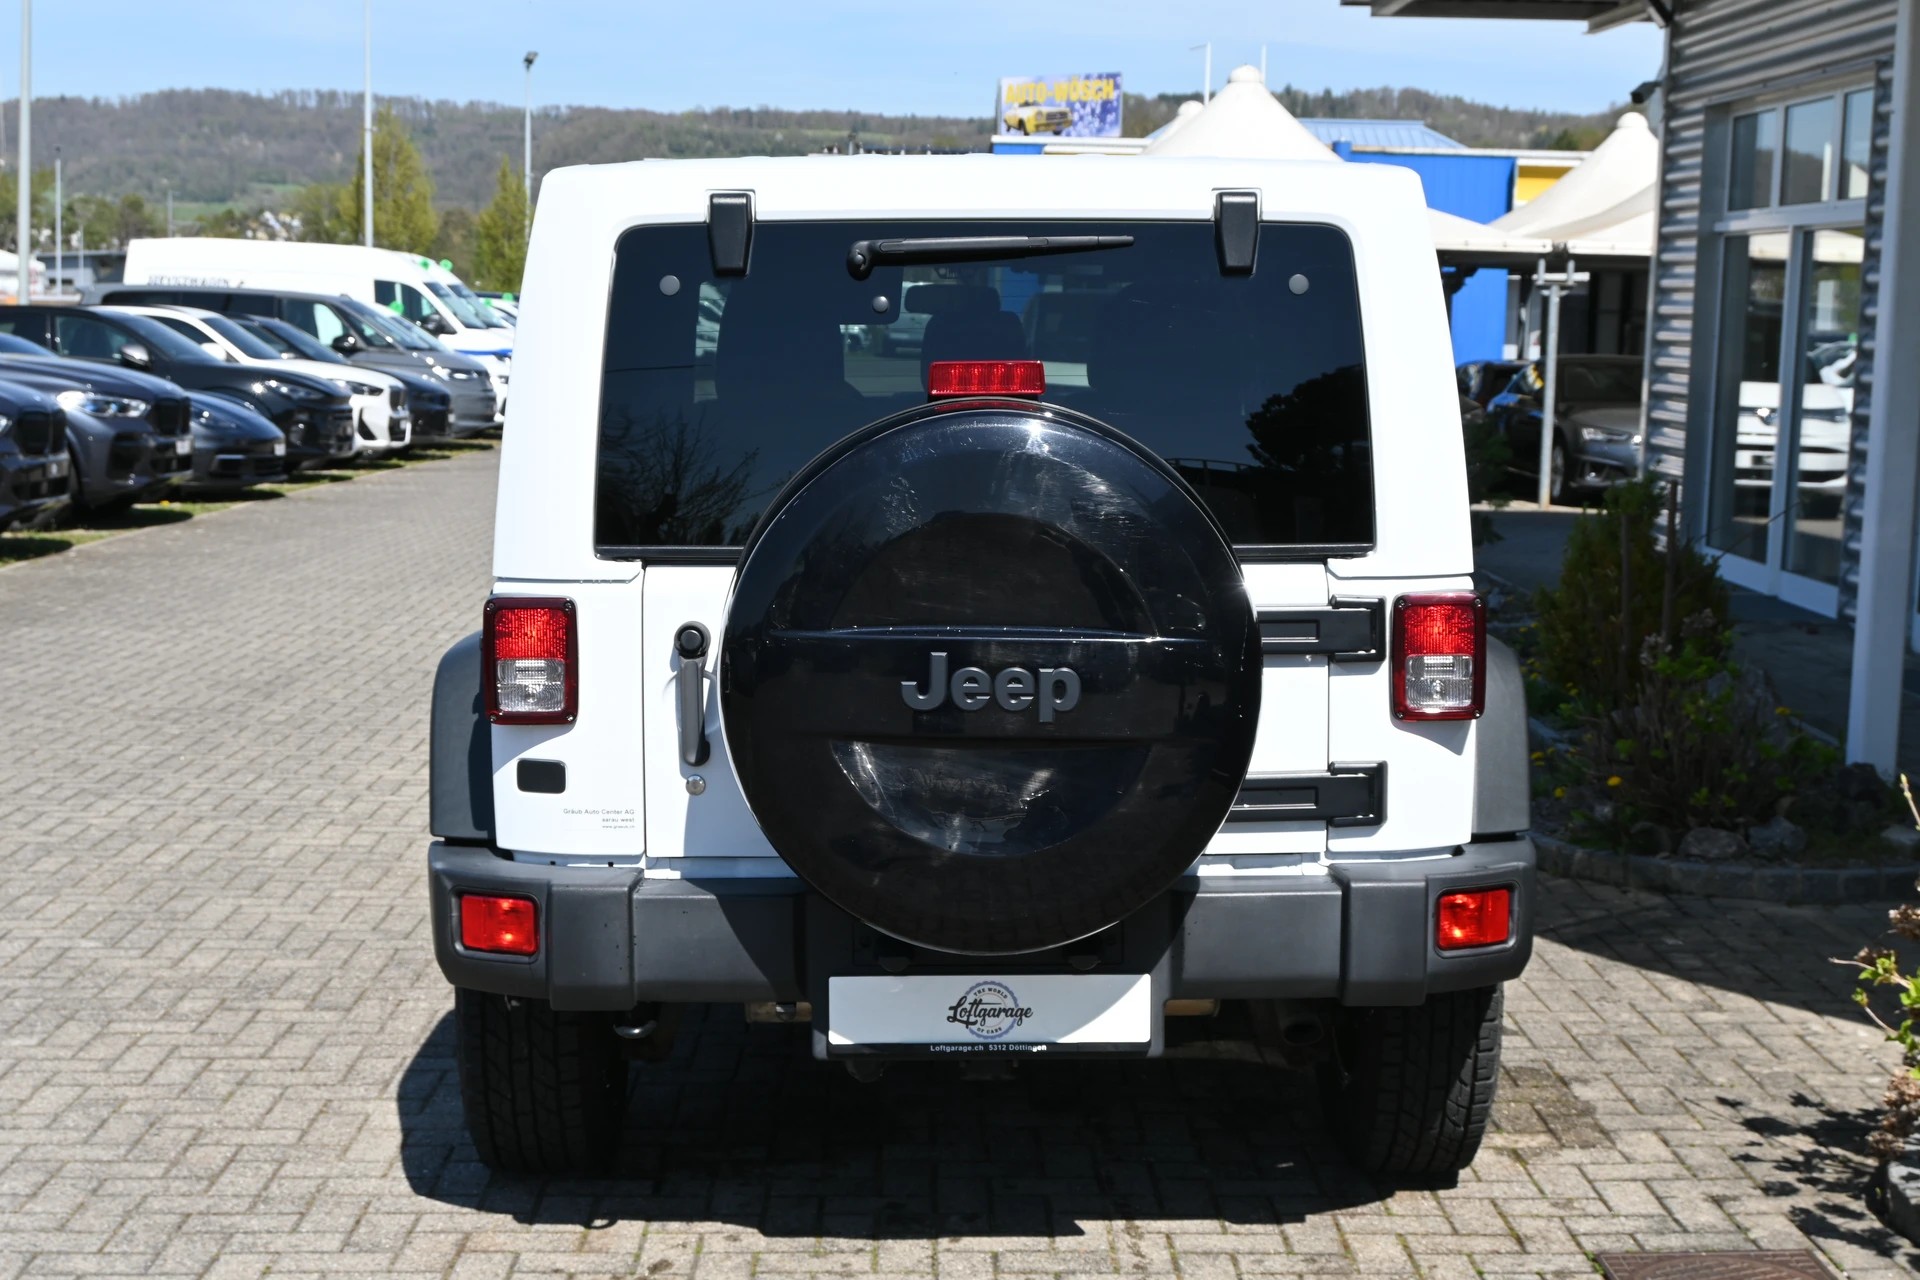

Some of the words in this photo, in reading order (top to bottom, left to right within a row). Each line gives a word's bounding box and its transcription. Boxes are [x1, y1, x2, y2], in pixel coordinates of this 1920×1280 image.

[1005, 75, 1114, 103] AUTO-WÖSCH
[900, 651, 1081, 723] Jeep
[973, 987, 986, 997] THE
[988, 987, 1008, 999] WORLD
[946, 996, 1034, 1029] Loftgarage
[930, 1044, 984, 1053] Loftgarage.ch
[1009, 1044, 1047, 1053] Döttingen
